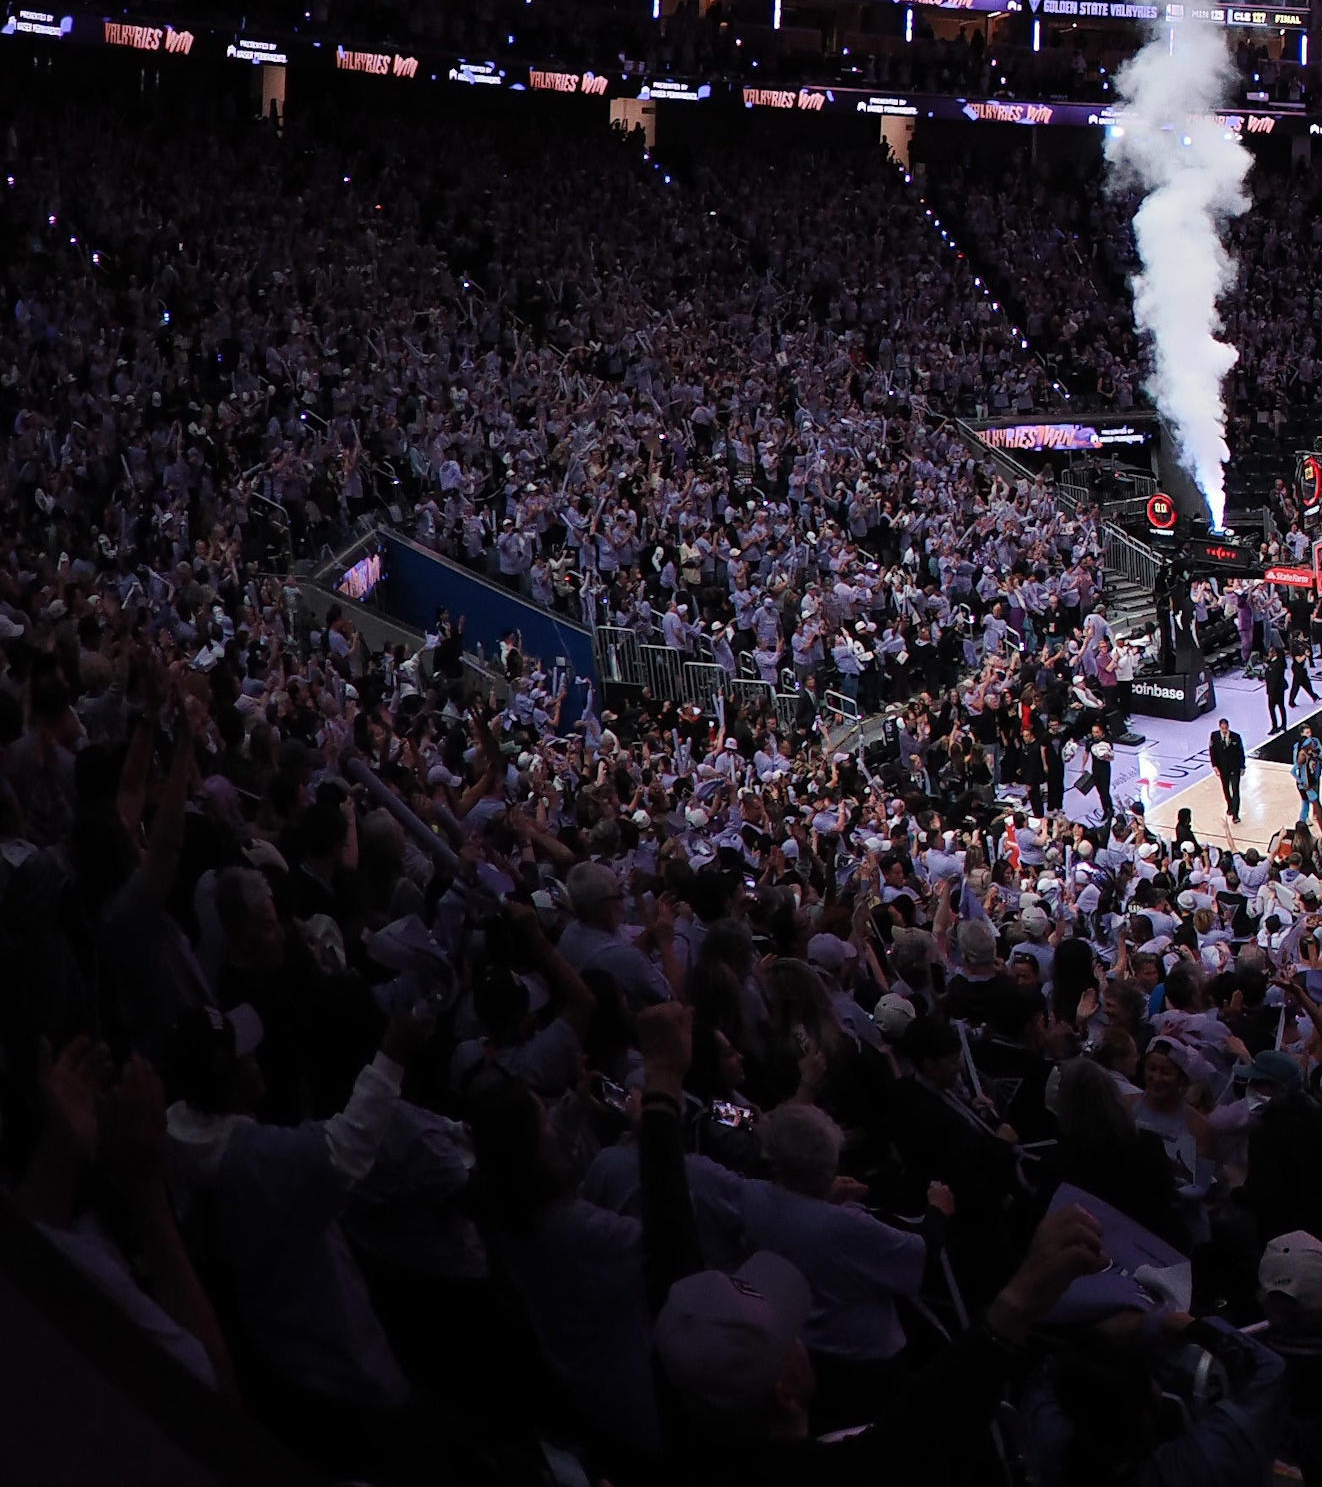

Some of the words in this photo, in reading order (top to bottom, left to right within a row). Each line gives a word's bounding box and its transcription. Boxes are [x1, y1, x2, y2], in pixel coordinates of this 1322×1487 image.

[1044, 0, 1077, 14] GOLDEN
[1079, 2, 1108, 16] STATE
[1110, 3, 1158, 18] VALKYRIES
[1275, 14, 1302, 25] FINAL
[105, 21, 163, 51] VALKYRIES
[164, 26, 194, 56] WIN
[336, 50, 391, 76] VALKYRIES
[393, 53, 418, 78] WIN
[529, 71, 579, 94] VALKYRIES
[580, 73, 608, 95] WIN
[743, 88, 796, 107] VALKYRIES
[798, 90, 825, 111] WIN
